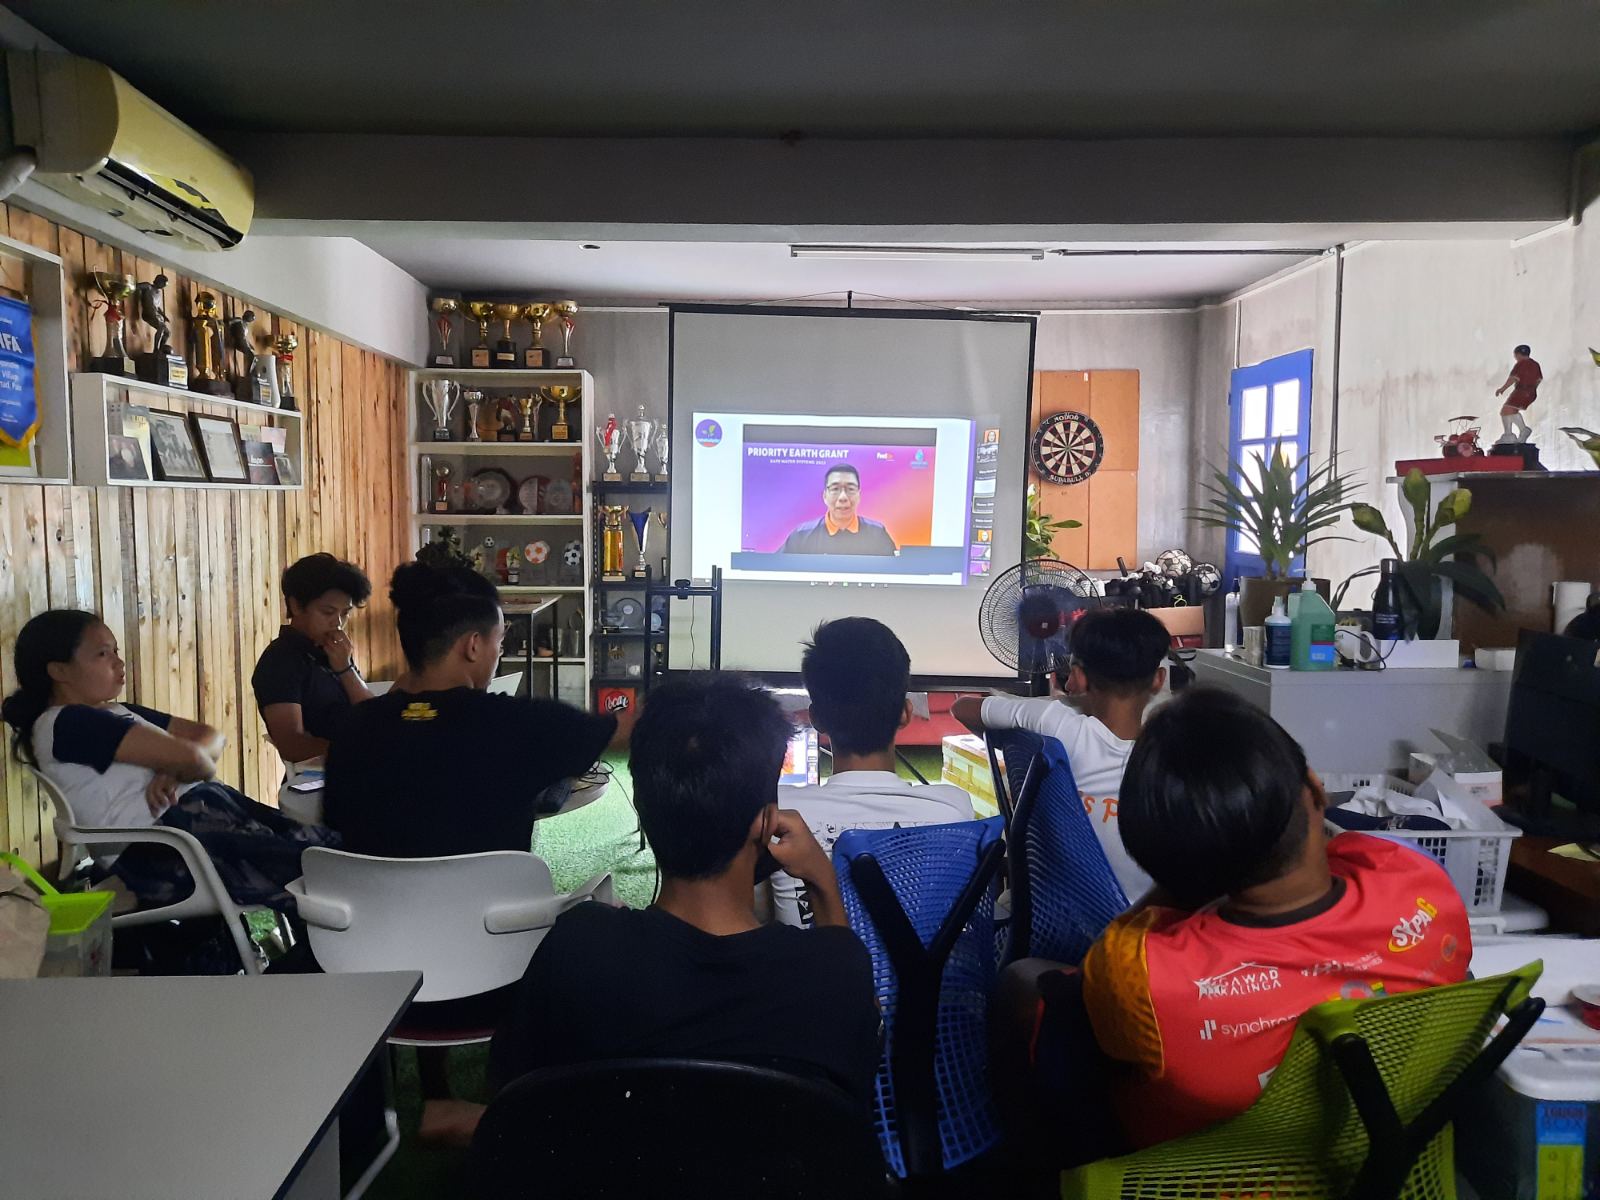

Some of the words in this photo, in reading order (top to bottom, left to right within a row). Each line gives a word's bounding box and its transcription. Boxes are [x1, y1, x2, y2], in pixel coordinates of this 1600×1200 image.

[747, 447, 788, 458] PRIORITY
[789, 448, 817, 458] EARTH
[819, 449, 849, 459] GRANT
